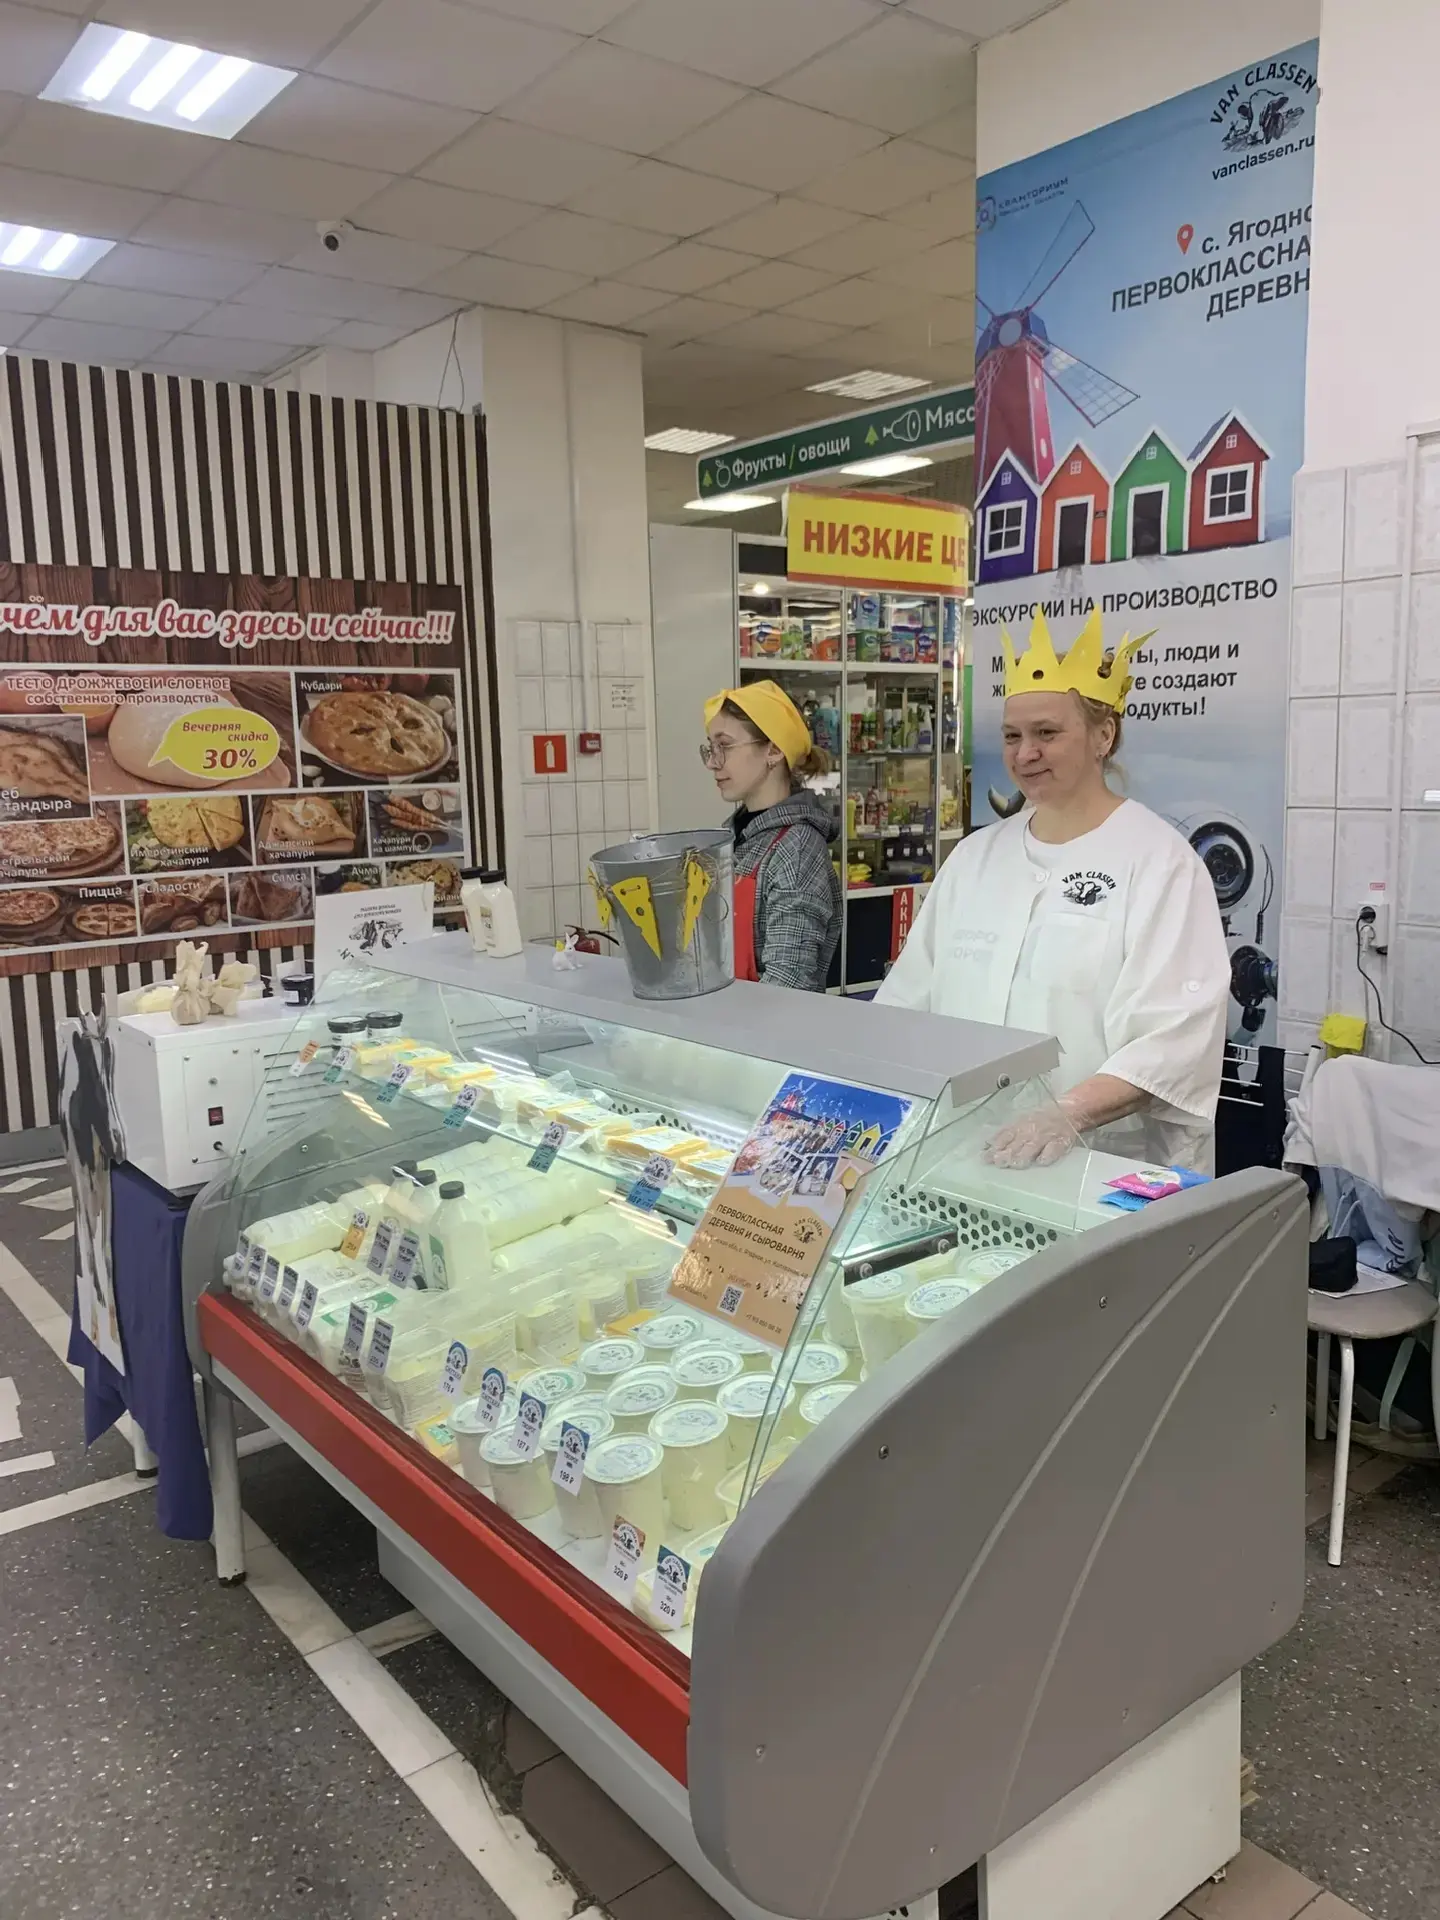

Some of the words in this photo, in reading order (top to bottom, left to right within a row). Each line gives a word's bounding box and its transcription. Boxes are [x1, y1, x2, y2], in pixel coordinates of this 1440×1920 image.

[1210, 84, 1240, 124] VAN
[1245, 62, 1317, 94] CLASSEN
[1212, 135, 1315, 180] vanclassen.ru
[1202, 237, 1220, 254] с.
[1112, 235, 1311, 313] ПЕРВОКЛАССНА
[1206, 268, 1310, 322] ДЕРЕВН
[732, 452, 786, 481] Фрукты
[798, 436, 851, 463] овощи
[804, 520, 933, 563] НИЗКИЕ
[1071, 597, 1095, 616] НА
[1102, 577, 1277, 614] ПРОИЗВОДСТВО
[83, 606, 152, 643] для
[157, 600, 214, 635] вас
[220, 611, 303, 645] здесь
[309, 616, 330, 639] и
[335, 609, 454, 642] сейчас!!!
[1164, 643, 1220, 663] люди
[1228, 644, 1239, 659] и
[7, 678, 53, 690] ТЕСТО
[57, 678, 150, 691] ДРОЖЖЕВОЕ
[152, 679, 163, 690] И
[167, 678, 230, 690] СЛОЕНОЕ
[301, 680, 342, 692] Кубдари
[1152, 671, 1237, 691] создают
[27, 693, 125, 705] собственного
[129, 693, 219, 706] производства
[1122, 697, 1206, 721] одукты!
[182, 722, 241, 734] Вечерняя
[228, 731, 269, 742] скидка
[203, 749, 257, 769] 30%
[6, 799, 72, 813] тандыра
[130, 845, 209, 858] Имеретинский
[258, 839, 315, 850] Аджарский
[373, 846, 383, 854] на
[160, 856, 209, 869] хачапури
[269, 849, 315, 861] хачапури
[271, 872, 307, 883] Самса
[351, 867, 378, 877] Ачма
[1062, 871, 1082, 884] VAN
[1086, 871, 1117, 890] CLASSEN
[79, 886, 123, 900] Пицца
[145, 880, 201, 894] Сладости
[716, 1203, 785, 1236] ПЕРВОКЛАССНАЯ
[708, 1216, 744, 1237] ДЕРЕВНЯ
[744, 1228, 752, 1239] И
[751, 1232, 805, 1261] СЫРОВАРНЯ
